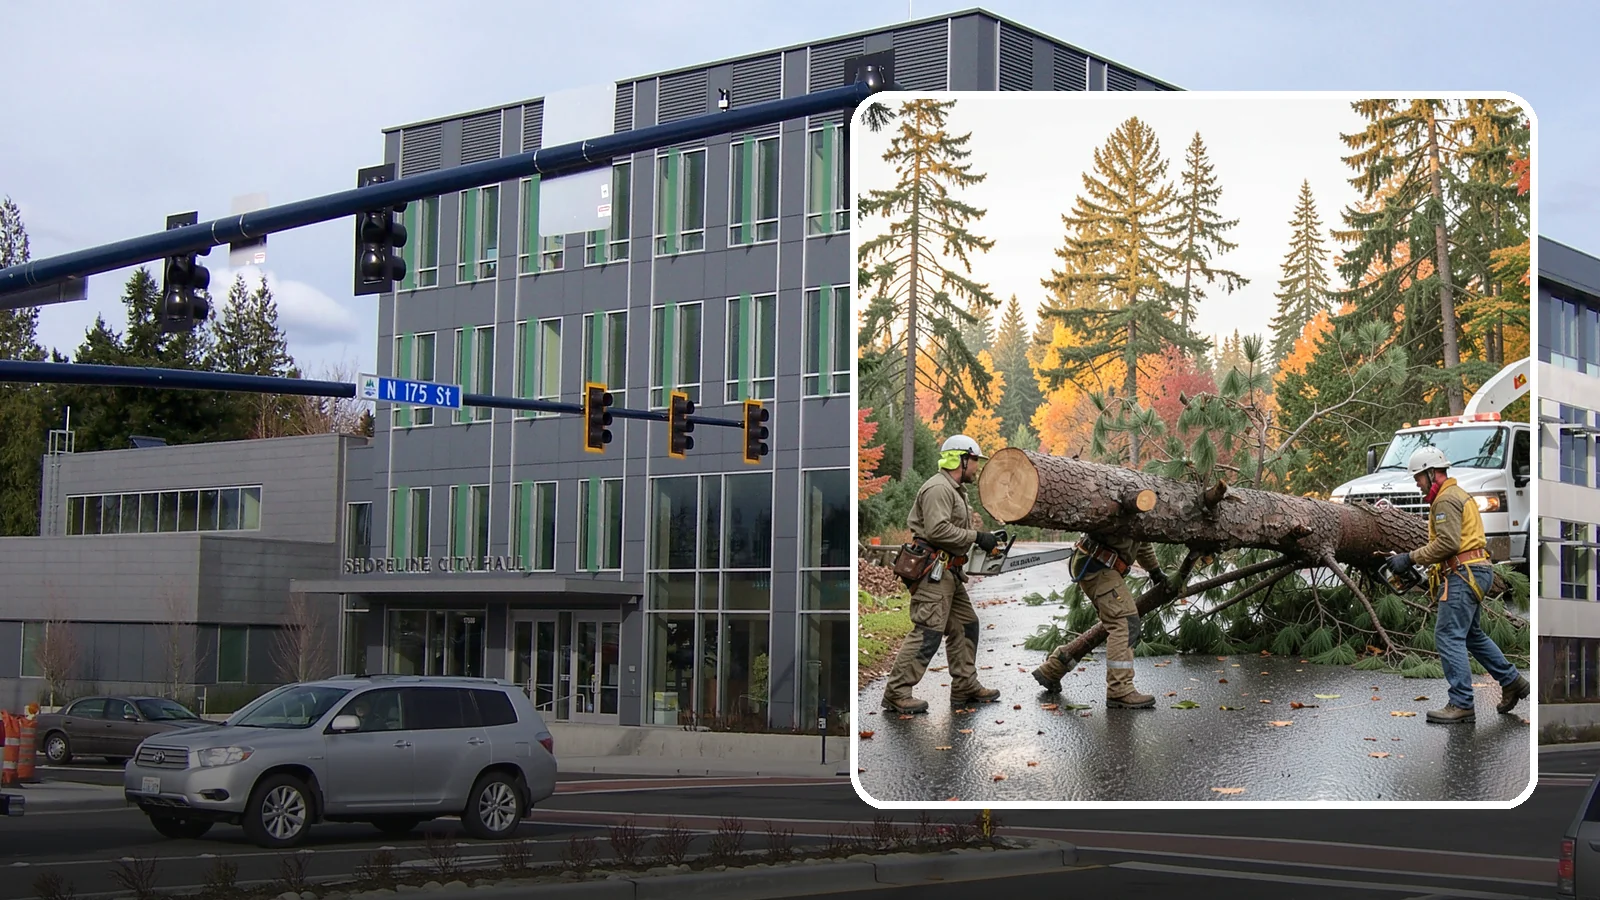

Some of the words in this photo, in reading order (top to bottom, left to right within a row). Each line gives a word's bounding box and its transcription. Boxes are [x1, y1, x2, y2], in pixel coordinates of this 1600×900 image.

[387, 381, 396, 400] N
[405, 383, 428, 403] 175
[436, 386, 452, 406] St
[344, 556, 432, 574] SHORELINE
[438, 556, 476, 572] CITY
[484, 555, 525, 572] HALL
